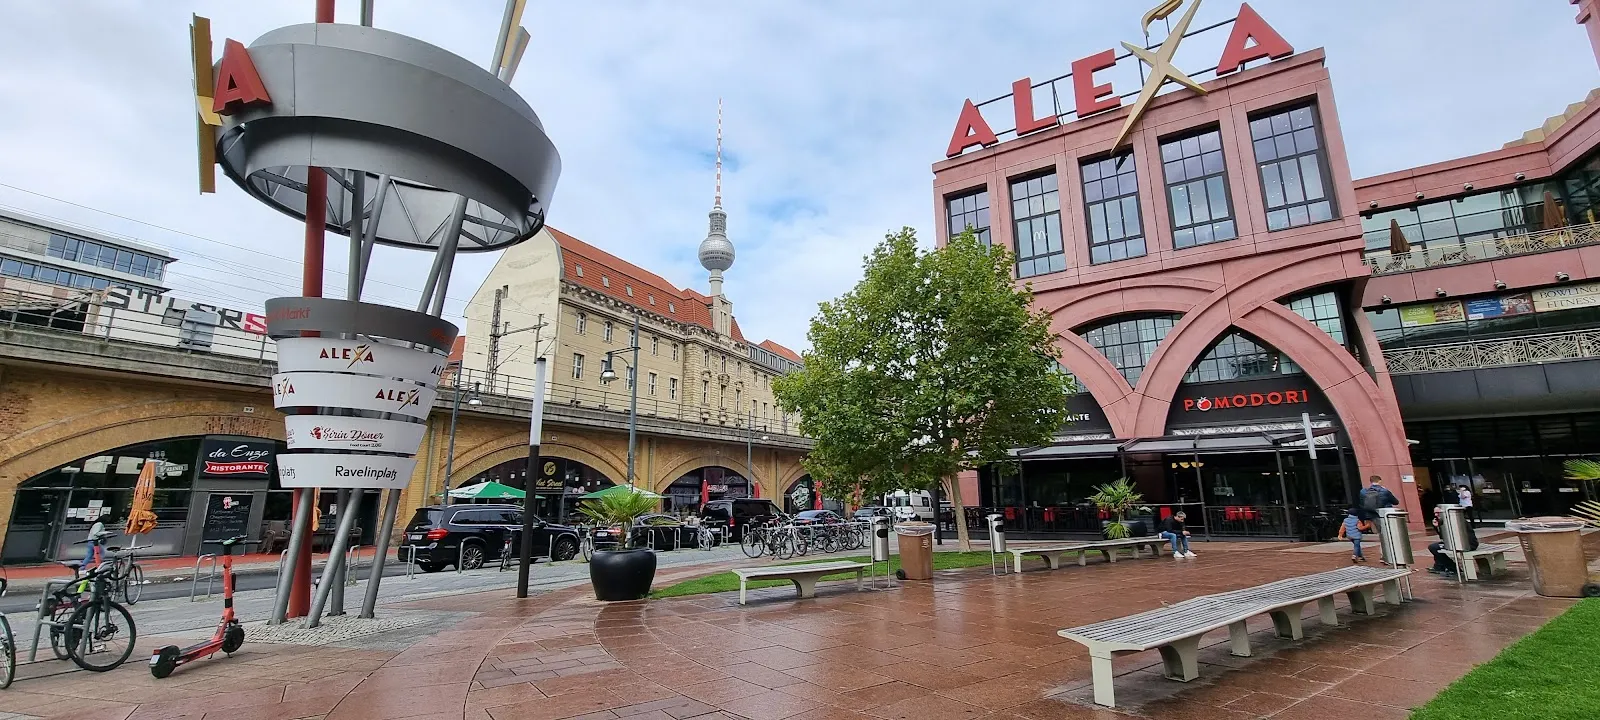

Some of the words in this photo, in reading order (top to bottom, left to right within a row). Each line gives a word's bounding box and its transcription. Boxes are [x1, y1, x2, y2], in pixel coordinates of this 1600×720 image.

[946, 0, 1295, 158] ALEXA
[1539, 285, 1598, 299] BOWLING
[1547, 296, 1596, 308] FITNESS
[319, 344, 374, 369] ALEXA
[274, 377, 296, 404] LEXA
[375, 388, 420, 411] ALEXA
[1184, 389, 1309, 411] POMODORI
[209, 448, 228, 458] da
[231, 445, 269, 461] Enzo
[210, 464, 263, 472] RISTORANTE
[335, 465, 397, 481] Ravelinplatz
